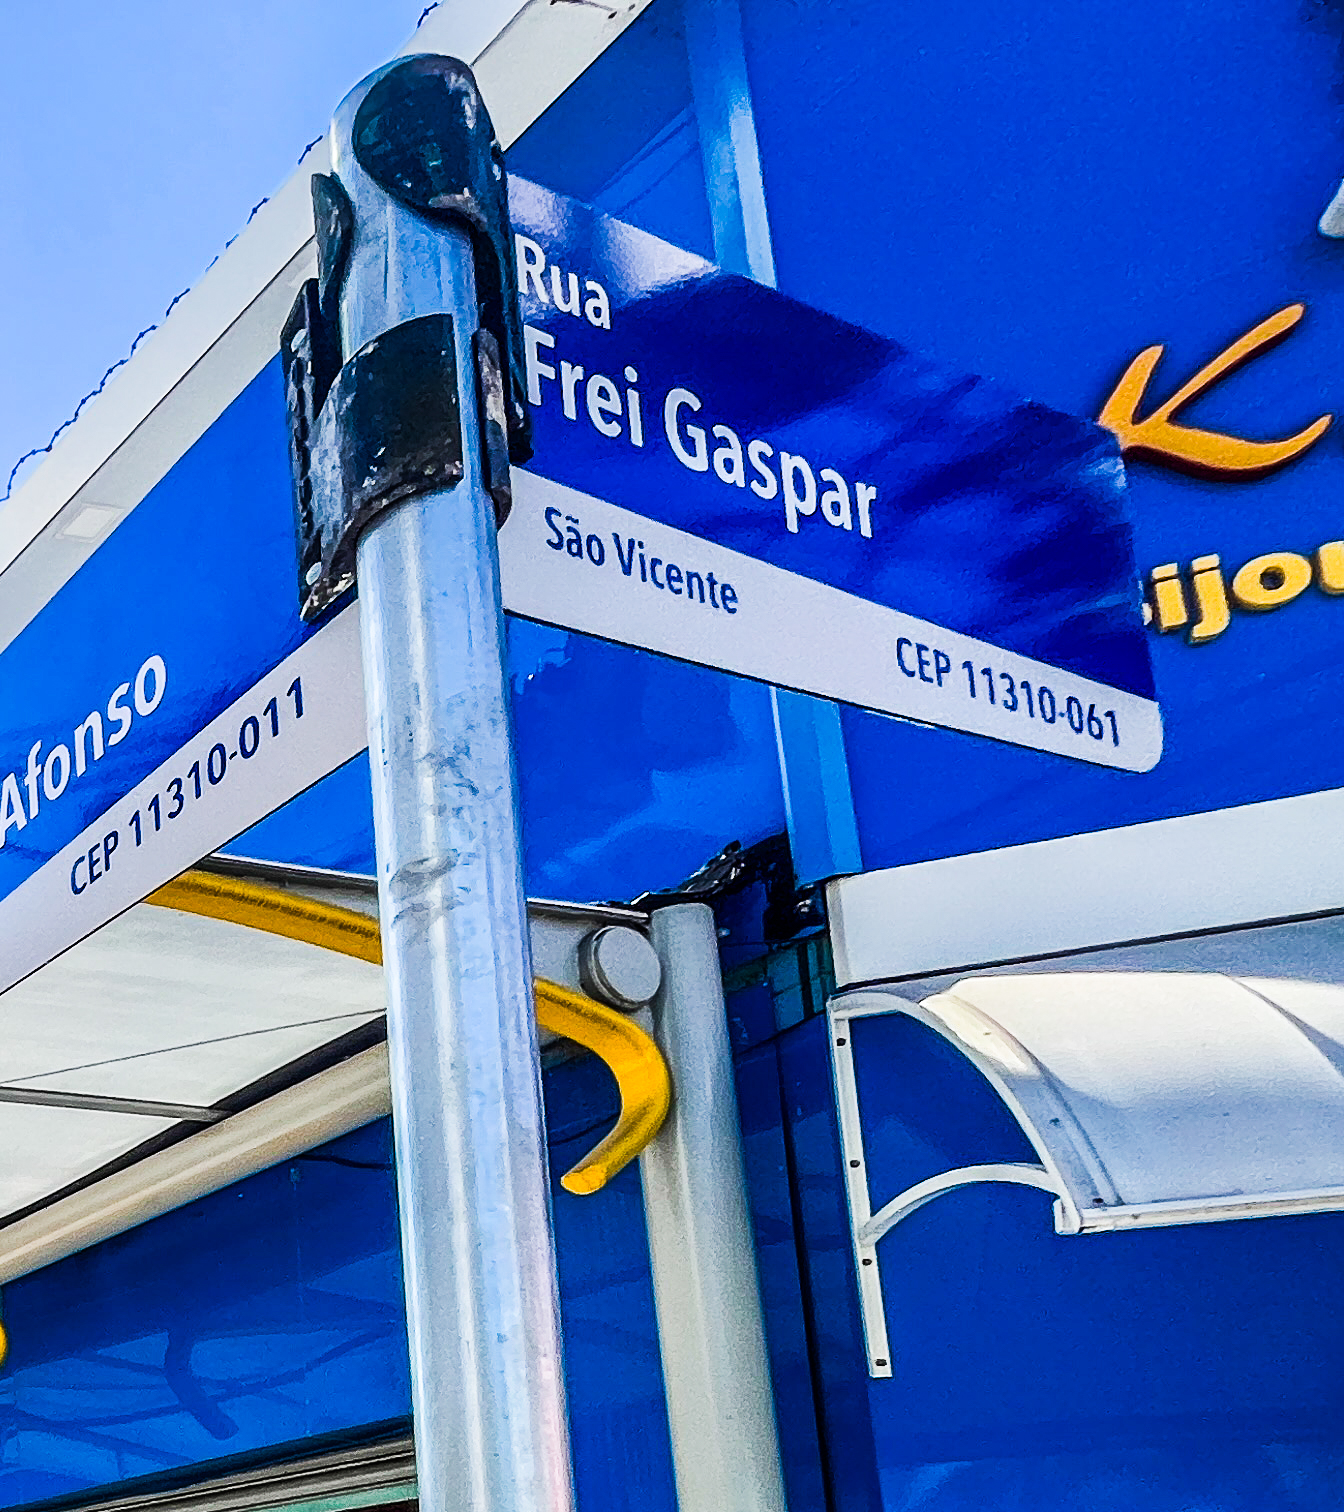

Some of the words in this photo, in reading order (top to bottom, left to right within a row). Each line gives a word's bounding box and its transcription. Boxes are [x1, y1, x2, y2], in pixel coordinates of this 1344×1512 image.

[513, 233, 612, 329] Rua
[523, 326, 644, 447] Frei
[664, 386, 879, 539] Gaspar
[544, 505, 605, 566] São
[613, 531, 739, 614] Vicente
[1142, 540, 1344, 644] ijo
[895, 635, 953, 689] CEP
[961, 660, 1120, 748] 11310-061
[70, 830, 120, 896] CEP
[127, 676, 306, 847] 11310-011
